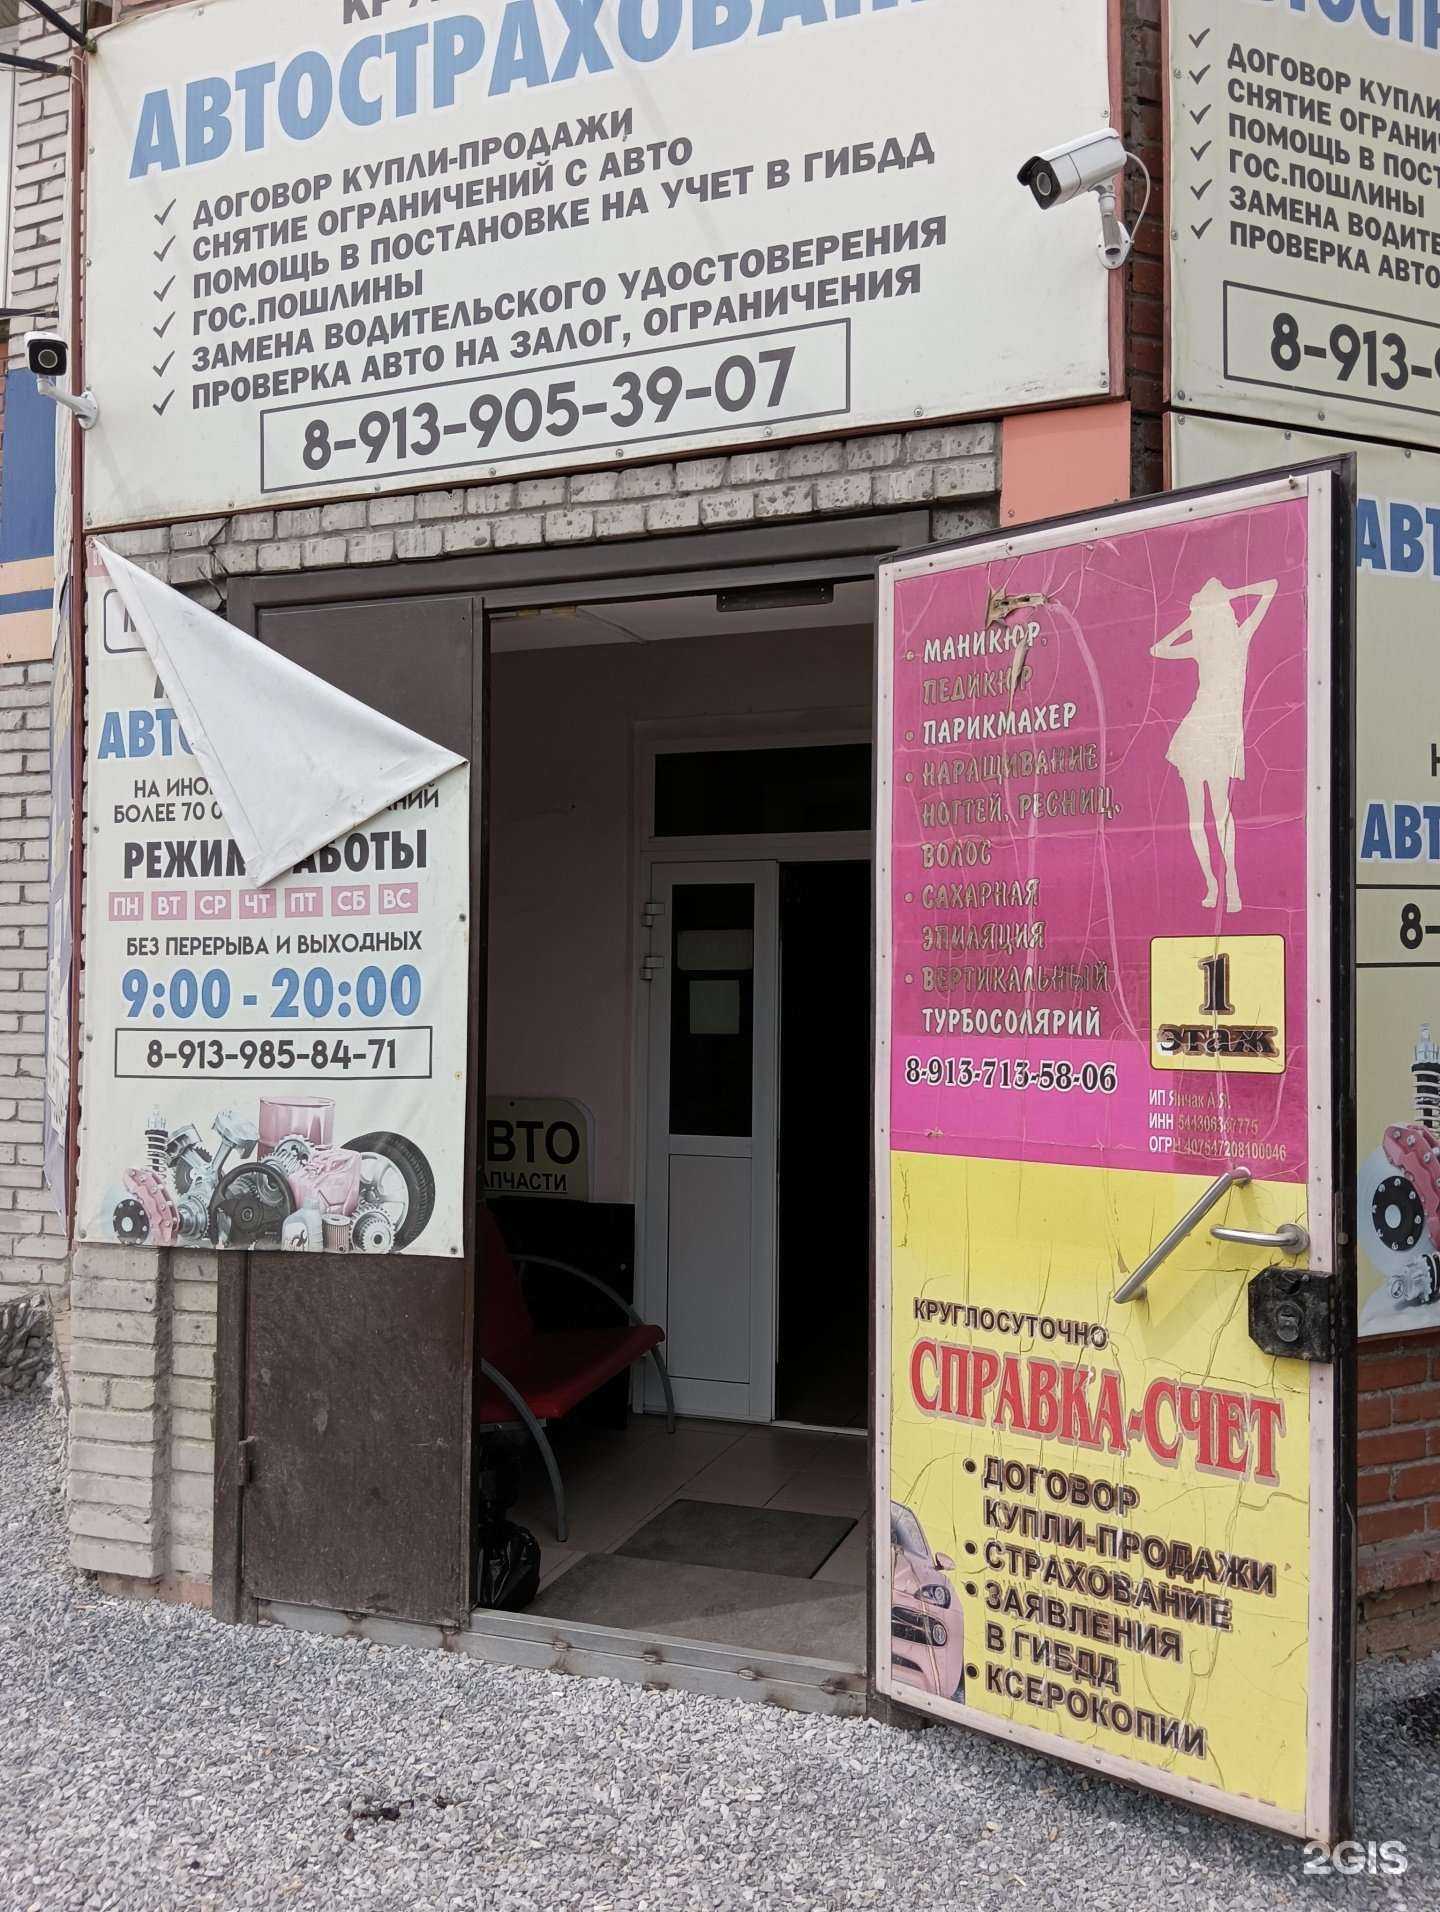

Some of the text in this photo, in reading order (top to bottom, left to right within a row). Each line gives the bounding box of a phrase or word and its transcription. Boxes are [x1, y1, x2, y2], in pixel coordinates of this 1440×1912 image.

[1227, 43, 1351, 95] ДОГОВОР
[1227, 78, 1440, 154] СНЯТИЕ ОГРАНИ
[1229, 113, 1350, 165] ПОМОЩЬ
[1359, 146, 1375, 171] В
[193, 107, 634, 230] ДОГОВОР КУПЛИ-ПРОДАЖИ
[1229, 148, 1424, 218] ГОС.ПОШЛИНЫ
[192, 136, 693, 262] СНЯТИЕ ОГРАНИЧЕНИЙ С АВТО
[193, 131, 935, 299] ПОМОЩЬ В ПОСТАНОВКЕ НА УЧЕТ В ГИБДД
[1229, 185, 1339, 232] ЗАМЕНА
[1229, 220, 1440, 289] ПРОВЕРКА АВТО
[192, 215, 947, 373] ЗАМЕНА ВОДИТЕЛЬСКОГО УДОСТОВЕРЕНИЯ
[193, 269, 424, 336] ГОС.ПОШЛИНЫ
[192, 264, 922, 410] ПРОВЕРКА АВТО НА ЗАЛОГ, ОГРАНИЧЕНИЯ
[1271, 312, 1440, 391] 8-913-
[302, 346, 797, 471] 8-913-905-39-07
[923, 702, 1077, 745] ПАРИКМАХЕР
[134, 779, 160, 798] НА
[922, 743, 1098, 786] НАРАЩИВАНИЕ
[114, 802, 176, 823] БОЛЕЕ
[182, 802, 205, 821] 70
[921, 839, 992, 868] ВОЛОС
[113, 888, 412, 917] ПН ВТ СР ЧТ ПТ СБ ВС
[921, 878, 1040, 910] САХАРНАЯ
[126, 931, 422, 957] БЕЗ ПЕРЕРЫВА И ВЫХОДНЫХ
[921, 921, 1047, 954] ЭПИЛЯЦИЯ
[122, 968, 231, 1019] 9:00
[270, 964, 421, 1019] 20:00
[921, 959, 1111, 993] ВЕРТИКАЛЬНЫЙ
[1199, 953, 1235, 1015] 1
[921, 1006, 1101, 1037] ТУРБОСОЛЯРИЙ
[146, 1038, 396, 1069] 8-913-985-84-71
[905, 1057, 1118, 1094] 8-913-713-58-06
[1149, 1089, 1166, 1106] ИП
[1149, 1113, 1174, 1130] ИНН
[912, 1297, 1108, 1350] КРУГЛОСУТОЧНО
[910, 1339, 1286, 1485] СПРАВКА-СЧЕТ
[983, 1456, 1138, 1514] ДОГОВОР
[983, 1499, 1276, 1597] КУПЛИ-ПРОДАЖИ
[984, 1541, 1232, 1631] СТРАХОВАНИЕ
[985, 1583, 1183, 1662] ЗАЯВЛЕНИЯ
[985, 1622, 1121, 1694] В ГИБДД
[986, 1664, 1207, 1760] КСЕРОКОПИИ
